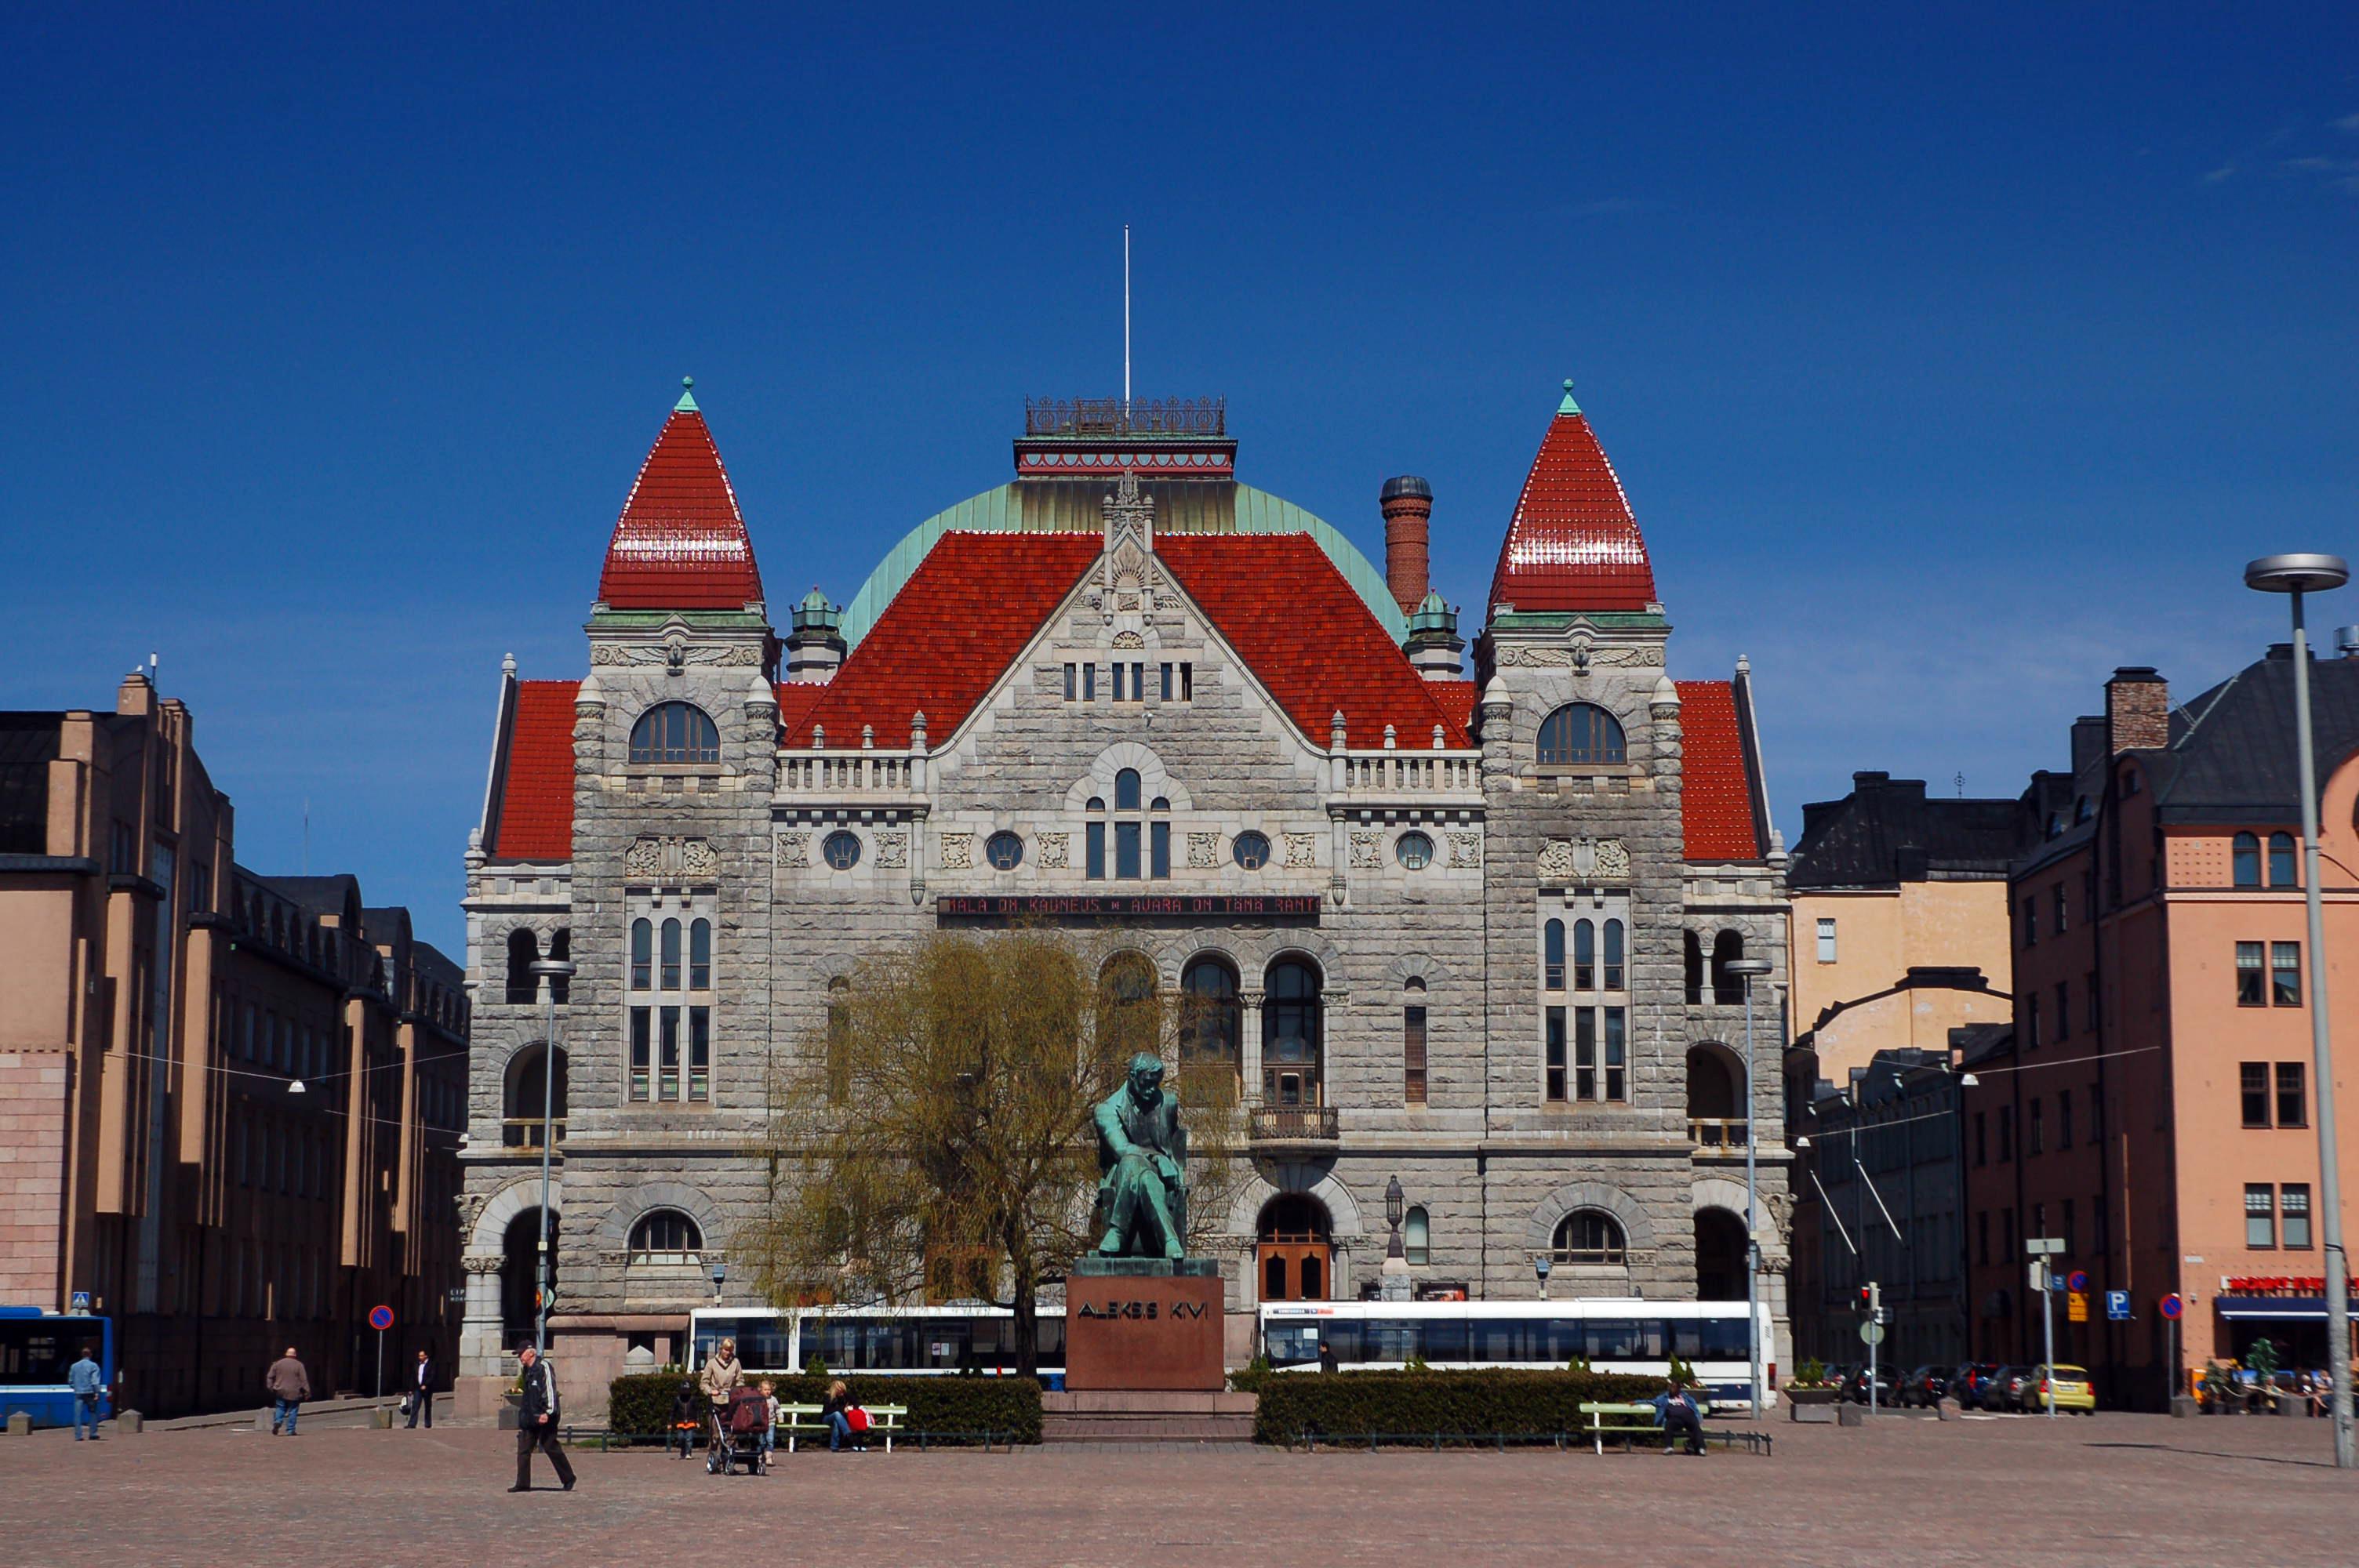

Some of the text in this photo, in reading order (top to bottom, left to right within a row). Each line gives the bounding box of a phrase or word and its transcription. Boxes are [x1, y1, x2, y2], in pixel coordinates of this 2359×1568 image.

[998, 898, 1018, 913] ON
[1029, 898, 1100, 913] KAUNEUS
[1131, 898, 1182, 913] AVARA
[1193, 898, 1212, 913] ON
[1078, 1301, 1209, 1320] ALEKSIS KIVI
[2111, 1292, 2125, 1311] P
